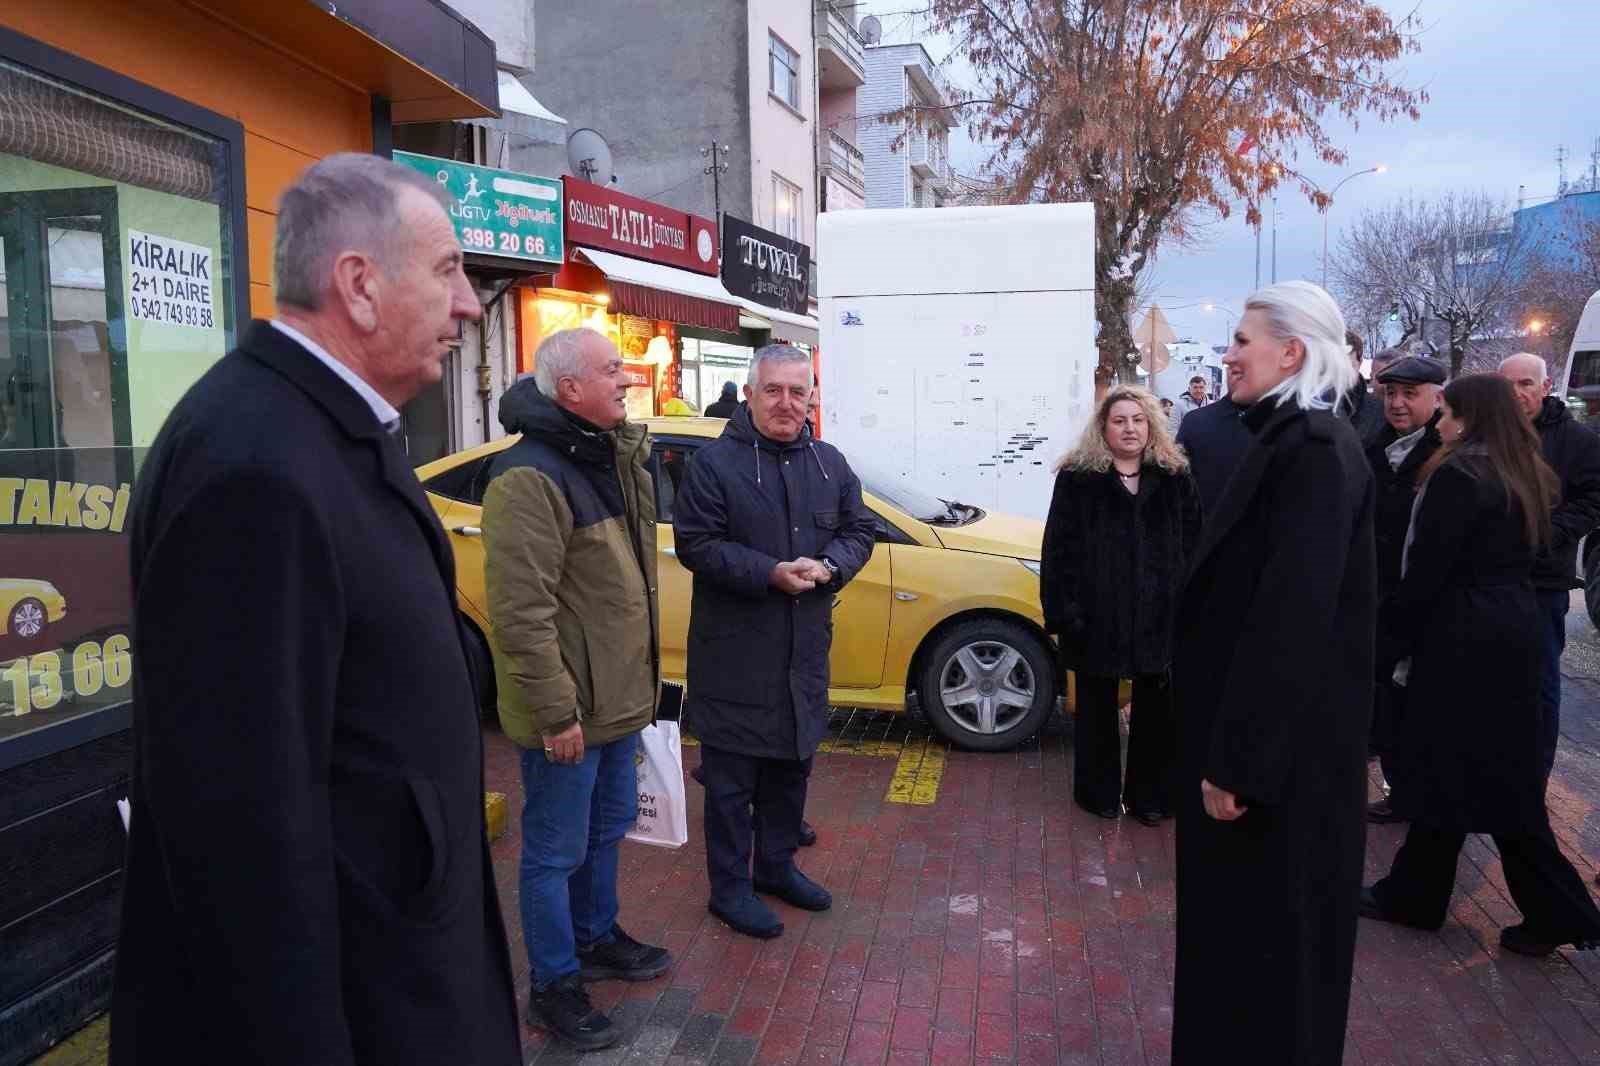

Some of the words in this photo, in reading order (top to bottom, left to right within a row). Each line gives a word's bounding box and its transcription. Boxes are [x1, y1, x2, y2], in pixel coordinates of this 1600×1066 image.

[462, 226, 495, 249] 398
[499, 231, 520, 253] 20
[525, 236, 545, 255] 66
[609, 203, 654, 249] TATLI
[131, 235, 209, 280] KİRALIK
[132, 271, 158, 295] 2+1
[163, 277, 211, 305] DAİRE
[131, 297, 139, 318] 0
[141, 298, 162, 321] 542
[164, 302, 183, 324] 743
[185, 305, 198, 326] 93
[200, 308, 213, 328] 58
[0, 477, 131, 532] TAKSİ
[2, 651, 64, 717] 13
[72, 634, 132, 697] 66
